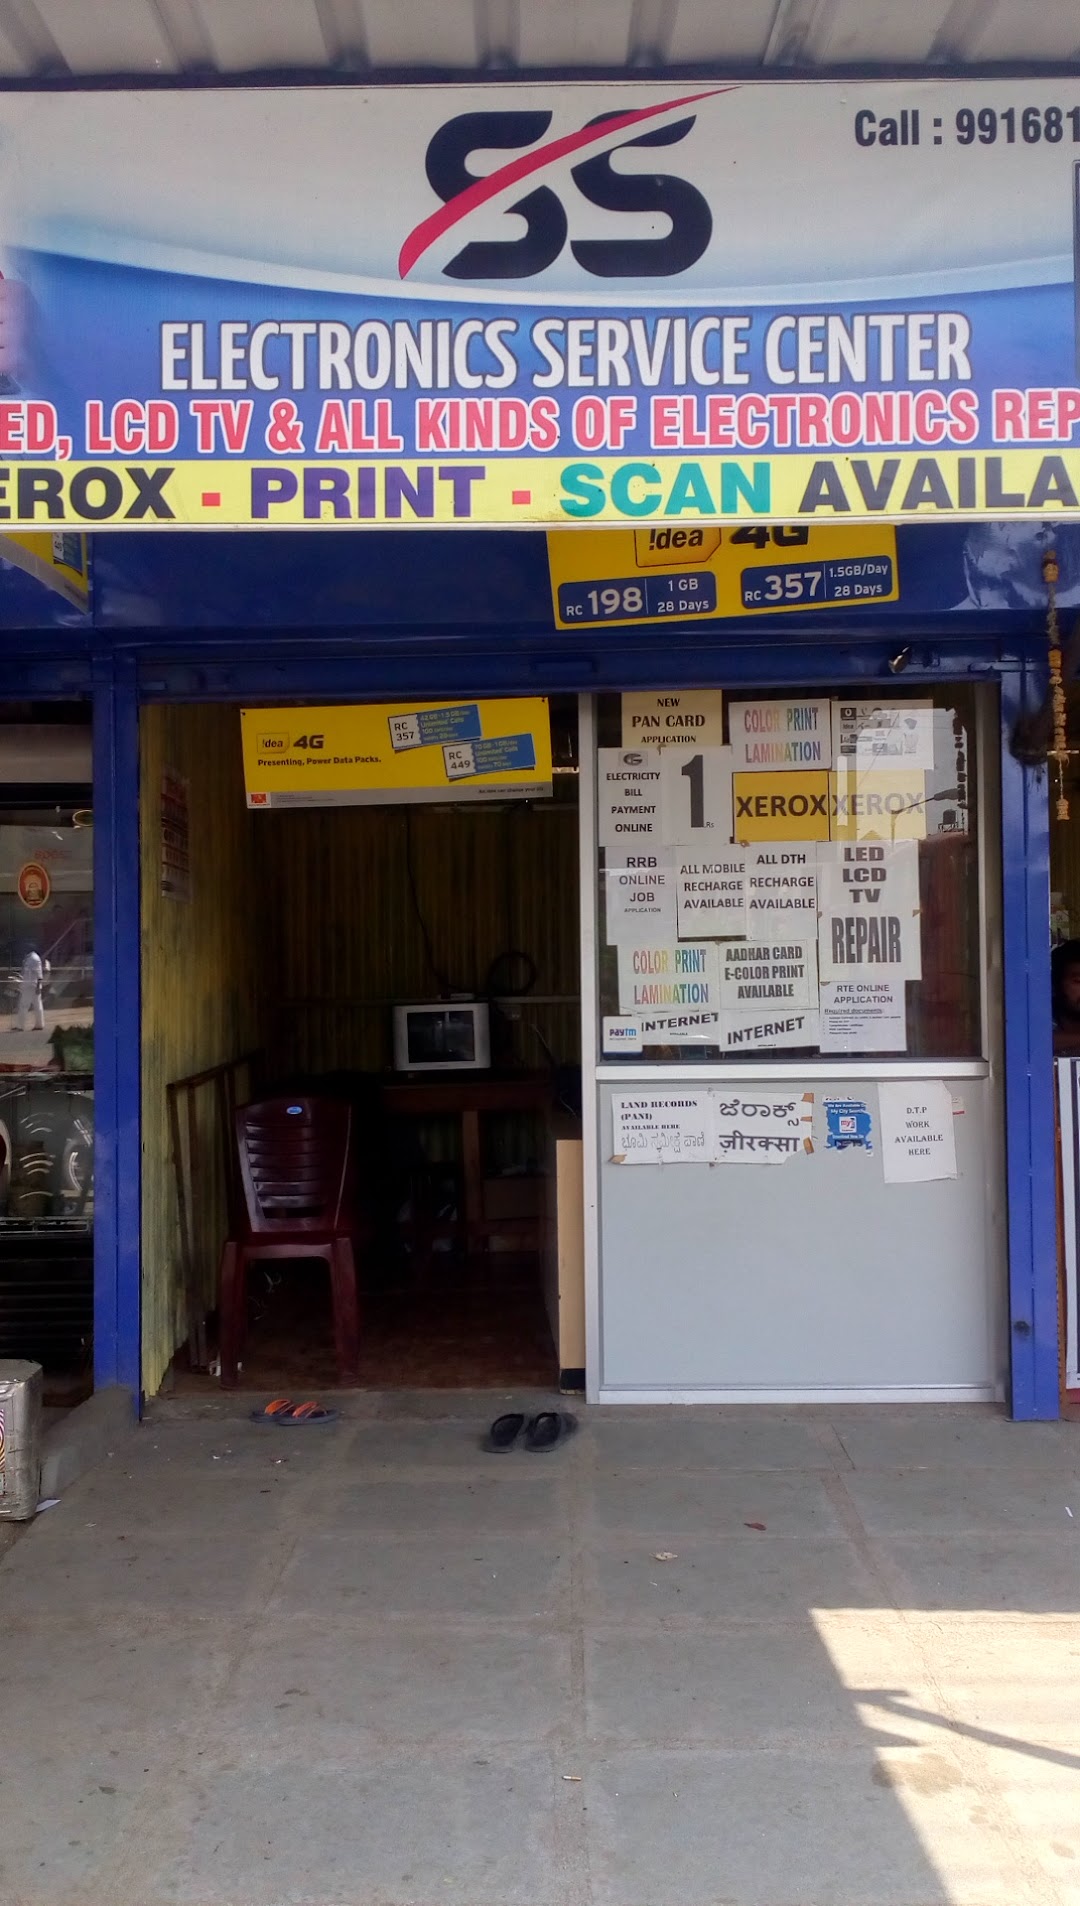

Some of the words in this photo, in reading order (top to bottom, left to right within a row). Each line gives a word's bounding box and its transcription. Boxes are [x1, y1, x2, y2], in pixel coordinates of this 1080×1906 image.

[854, 109, 920, 146] Call
[955, 106, 1080, 145] 991681
[161, 319, 516, 391] ELECTRONICS
[532, 315, 751, 389] SERVICE
[765, 312, 972, 385] CENTER
[86, 399, 178, 453] LCD
[191, 399, 253, 453] TV
[266, 399, 304, 453] &
[317, 398, 403, 452] ALL
[415, 396, 560, 451] KINDS
[573, 395, 637, 449] OF
[650, 389, 979, 448] ELECTRONICS
[992, 387, 1080, 441] REP
[0, 466, 176, 519] ROX
[249, 465, 486, 519] PRINT
[559, 460, 771, 517] SCAN
[798, 456, 1080, 514] AVAILA
[829, 563, 888, 579] 1.5GB/Day
[678, 578, 699, 592] GB
[744, 590, 762, 602] RC
[764, 572, 822, 601] 357
[834, 585, 851, 598] 28
[854, 583, 883, 597] Days
[566, 606, 584, 617] RC
[587, 587, 643, 616] 198
[657, 600, 677, 613] 28
[679, 599, 710, 613] Days
[656, 698, 681, 707] NEW
[631, 715, 660, 728] PAN
[665, 714, 706, 728] CARD
[744, 708, 781, 733] COLOR
[786, 707, 819, 732] PRINT
[394, 721, 408, 732] RC
[293, 734, 324, 750] 4G
[396, 731, 415, 742] 357
[640, 735, 697, 744] APPLICATION
[448, 751, 462, 761] RC
[744, 740, 821, 764] LAMINATION
[258, 758, 305, 767] Presenting,
[306, 757, 332, 765] Power
[333, 756, 353, 764] Data
[354, 755, 382, 764] Packs.
[450, 760, 471, 770] 449
[606, 771, 661, 781] ELECTRICITY
[624, 788, 643, 797] BILL
[611, 805, 656, 814] PAYMENT
[736, 794, 828, 818] XEROX
[831, 792, 924, 817] XEROX
[614, 823, 653, 832] ONLINE
[756, 854, 778, 865] ALL
[781, 854, 806, 864] DTH
[844, 847, 885, 862] LED
[626, 856, 658, 868] RRB
[680, 864, 700, 875] ALL
[702, 863, 746, 874] MOBILE
[842, 867, 887, 883] LCD
[618, 874, 666, 885] ONLINE
[749, 876, 815, 888] RECHARGE
[683, 880, 743, 892] RECHARGE
[629, 892, 655, 902] JOB
[849, 888, 882, 903] TV
[683, 898, 744, 909] AVAILABLE
[749, 898, 815, 909] AVAILABLE
[831, 915, 903, 964] REPAIR
[725, 947, 770, 962] AADHAR
[771, 945, 803, 960] CARD
[633, 949, 669, 975] COLOR
[675, 948, 707, 974] PRINT
[724, 965, 770, 981] E-COLOR
[771, 964, 805, 979] PRINT
[633, 982, 709, 1005] LAMINATION
[737, 983, 795, 1000] AVAILABLE
[836, 984, 854, 993] RTE
[856, 984, 890, 993] ONLINE
[833, 995, 894, 1004] APPLICATION
[641, 1012, 719, 1032] INTERNET
[727, 1016, 806, 1045] INTERNET
[620, 1101, 648, 1109] LAND
[650, 1100, 698, 1108] RECORDS
[906, 1106, 928, 1115] D.T.P
[620, 1113, 653, 1121] (PANI)
[905, 1120, 930, 1129] WORK
[894, 1134, 944, 1143] AVAILABLE
[908, 1147, 932, 1156] HERE
